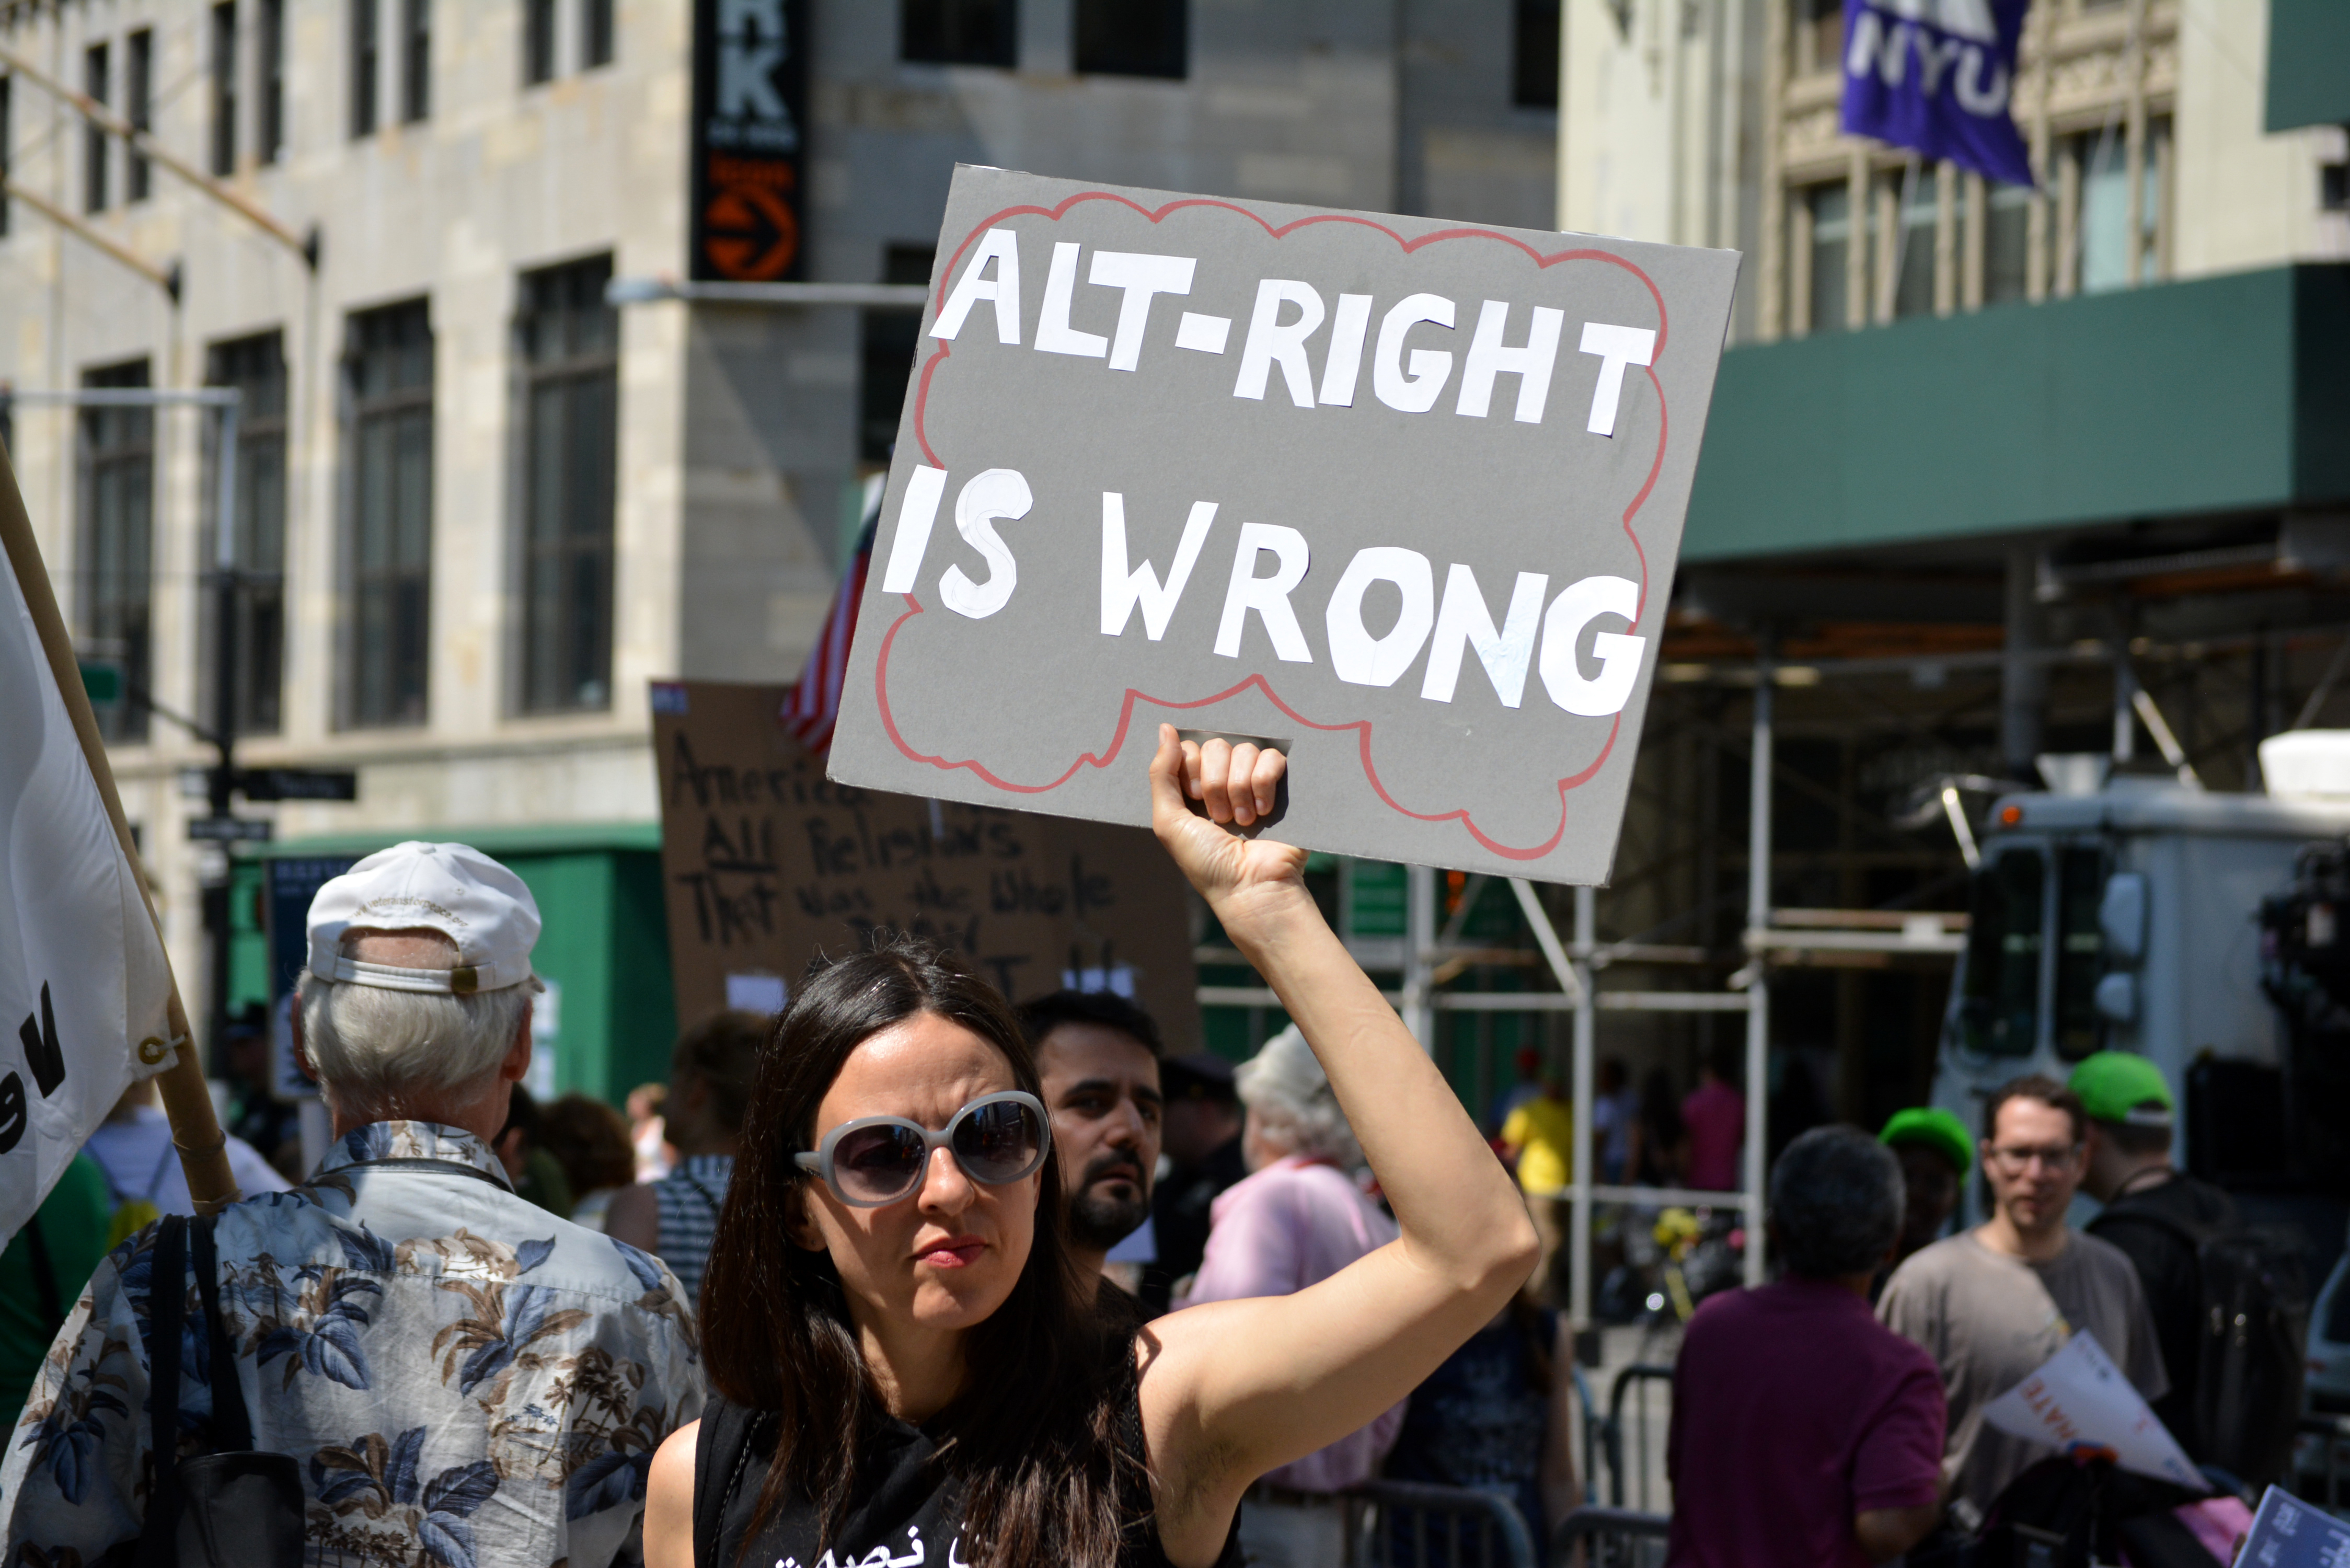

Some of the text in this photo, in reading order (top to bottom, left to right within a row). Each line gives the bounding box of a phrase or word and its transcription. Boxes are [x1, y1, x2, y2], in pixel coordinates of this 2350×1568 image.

[1847, 9, 2009, 116] NYU
[928, 227, 1656, 438] ALT-RIGHT
[881, 463, 1646, 717] IS WRONG
[347, 896, 468, 927] wwwveteransforpeace.org
